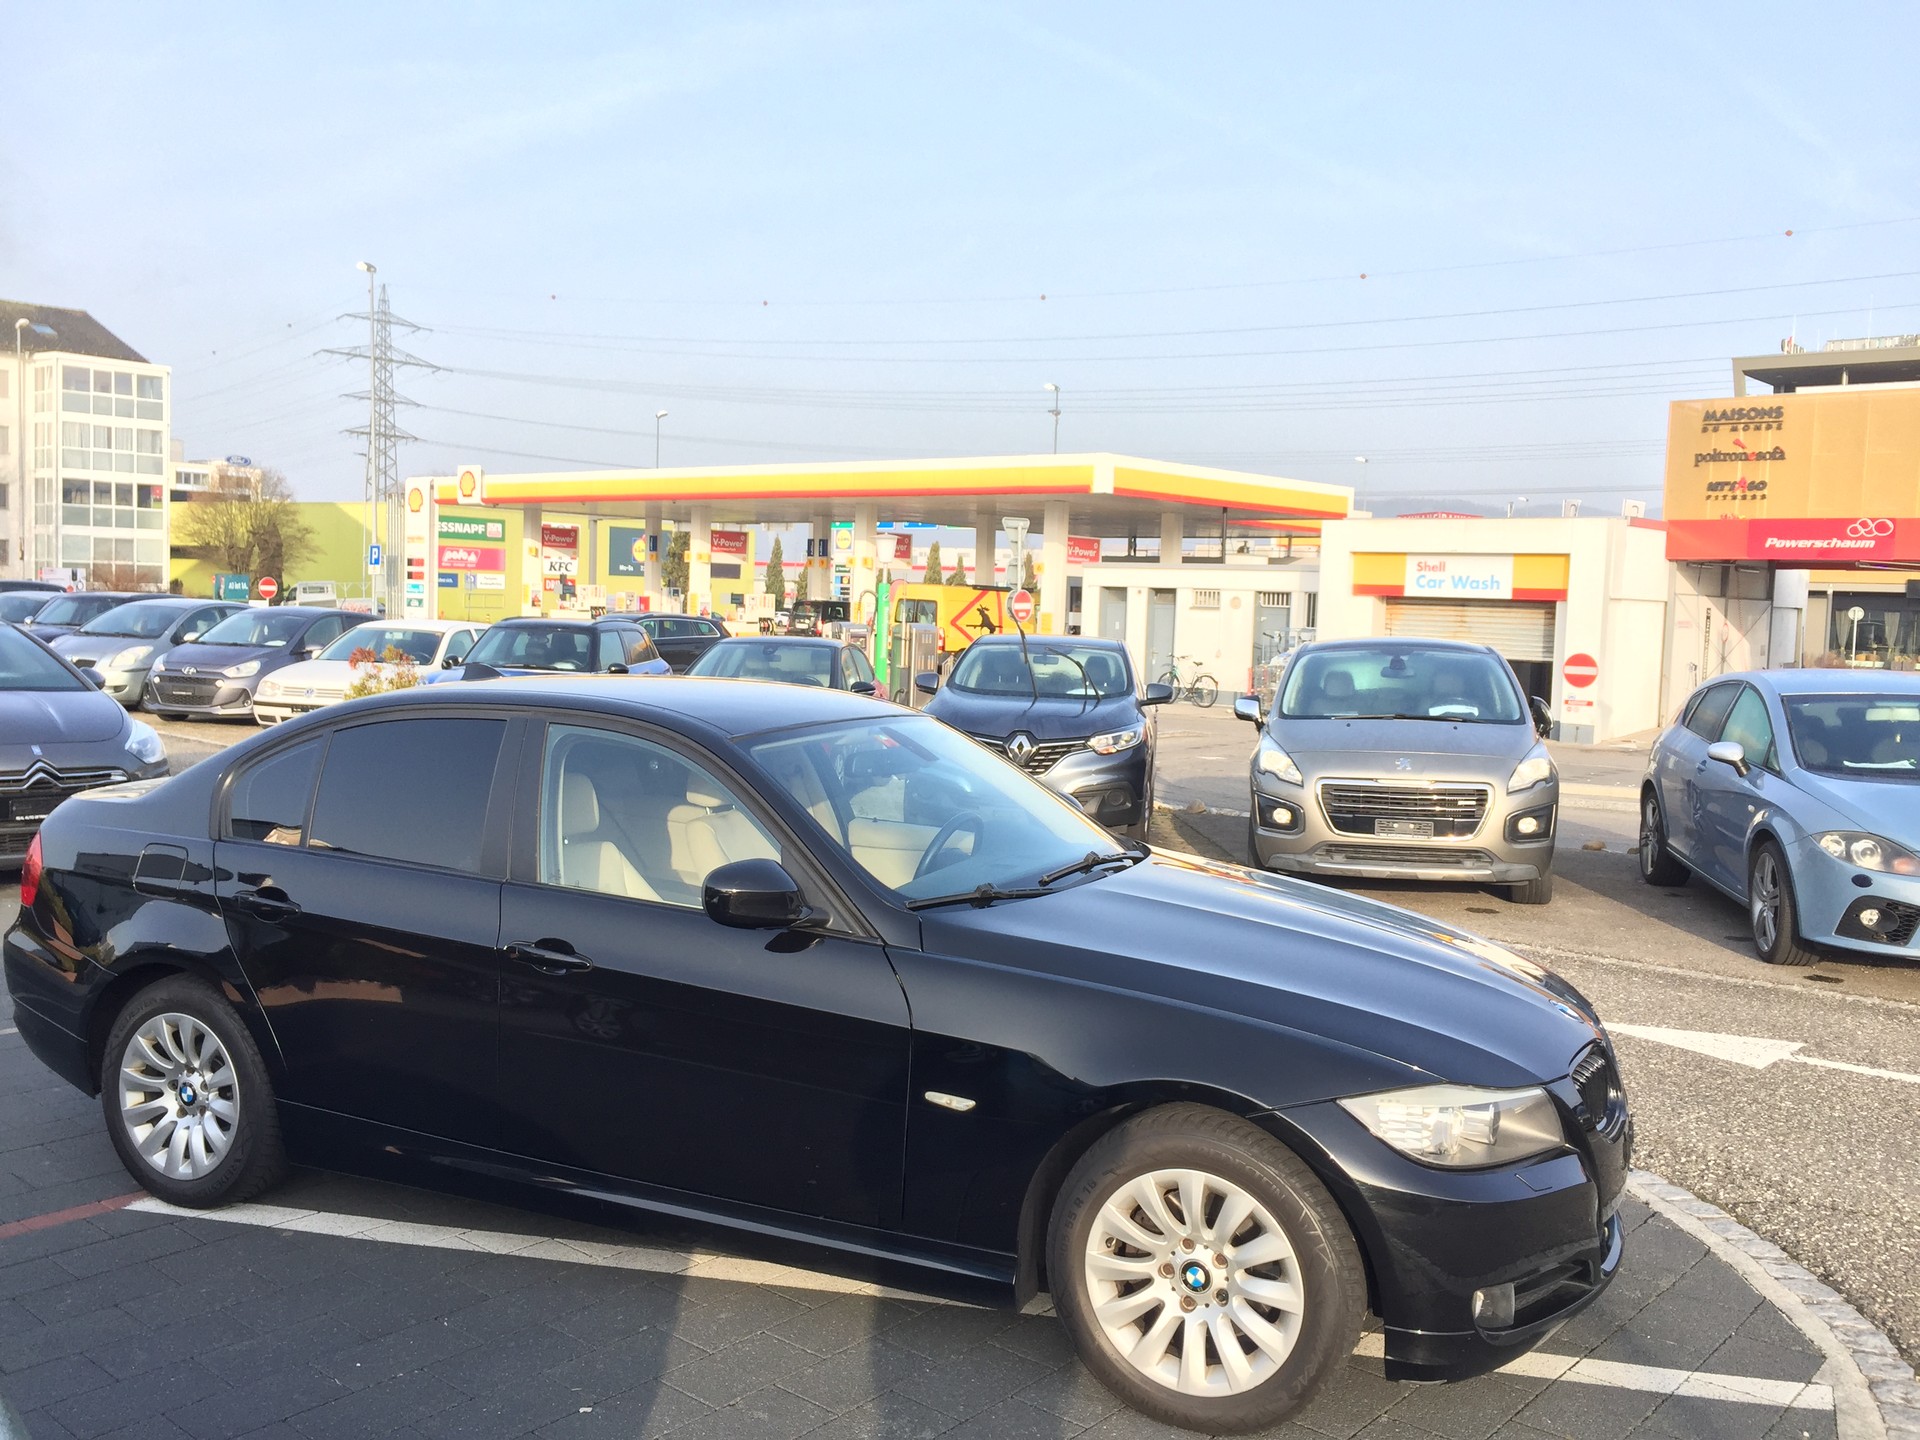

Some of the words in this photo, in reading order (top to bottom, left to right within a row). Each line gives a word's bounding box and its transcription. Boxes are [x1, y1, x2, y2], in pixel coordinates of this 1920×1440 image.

[1703, 406, 1784, 422] MAISONS
[1702, 425, 1719, 433] DU
[1730, 423, 1783, 433] MONDE
[543, 534, 574, 543] V-Power
[712, 538, 743, 547] V-Power
[1765, 537, 1876, 549] Powerschaum
[371, 547, 379, 565] P
[549, 561, 573, 572] KFC
[1416, 561, 1447, 573] Shell
[1415, 575, 1446, 590] Car
[1451, 576, 1501, 591] Wash
